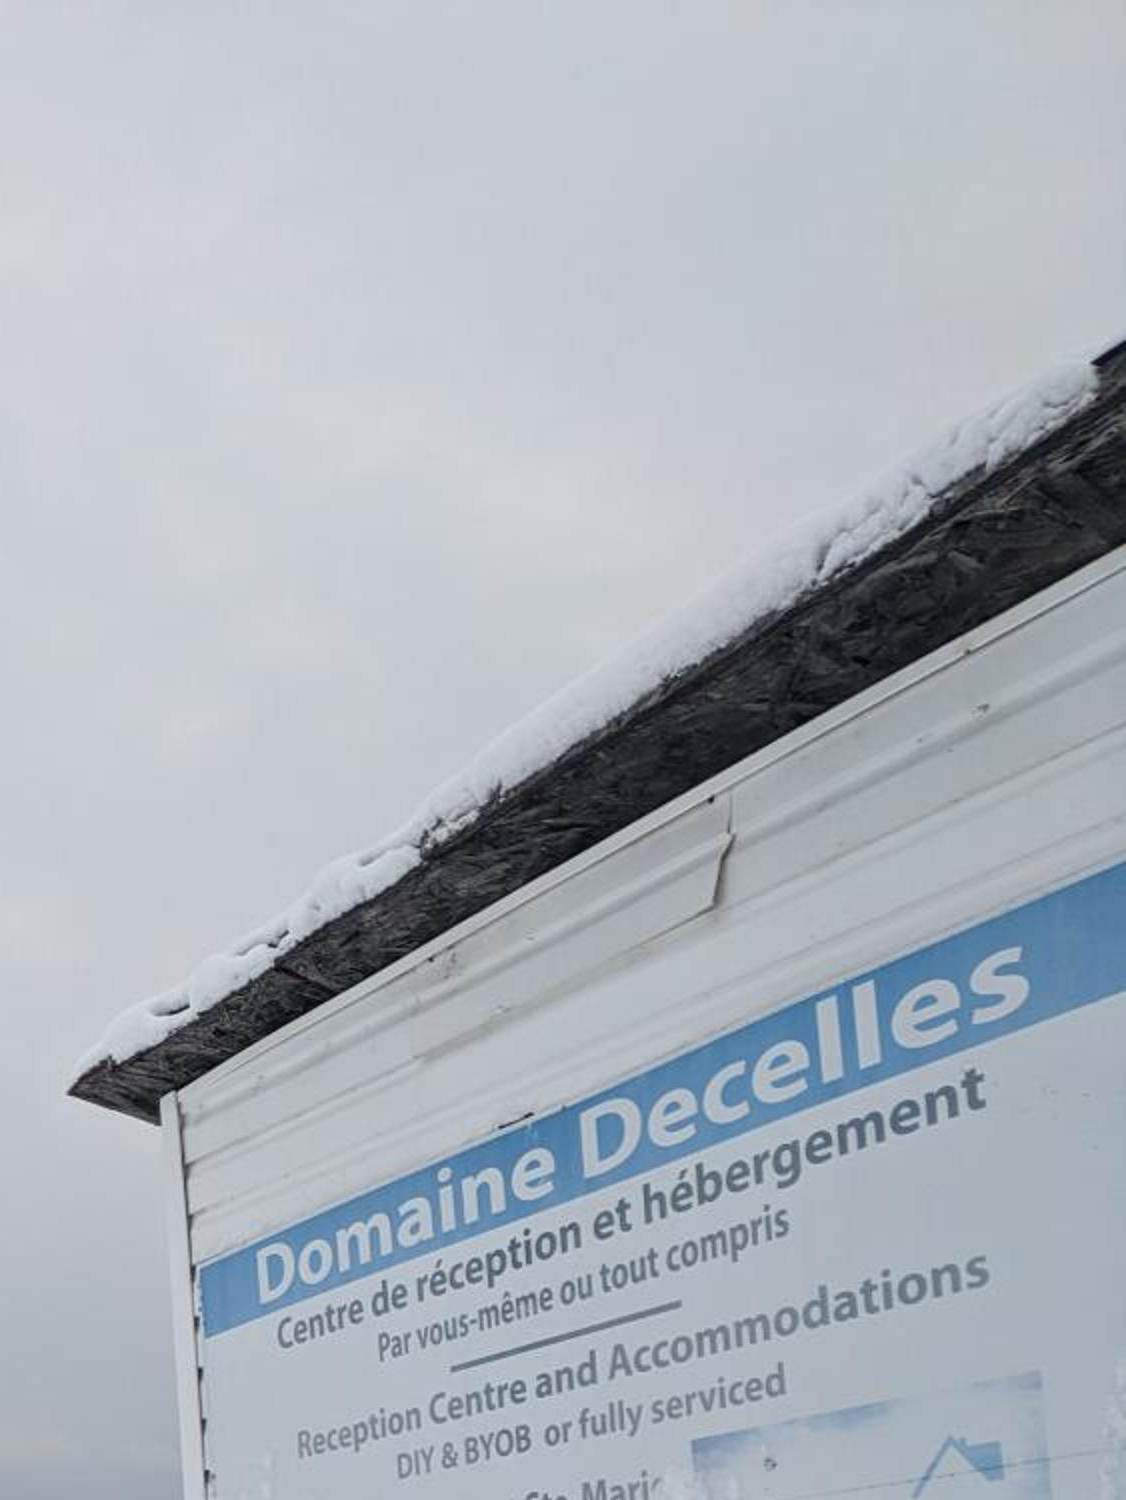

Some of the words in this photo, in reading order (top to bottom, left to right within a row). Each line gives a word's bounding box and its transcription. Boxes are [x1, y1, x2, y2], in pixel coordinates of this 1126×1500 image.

[257, 1144, 555, 1304] Domaine
[579, 946, 1030, 1179] Decelles
[277, 1299, 364, 1349] Centre
[371, 1279, 408, 1317] de
[416, 1219, 582, 1302] réception
[592, 1196, 632, 1241] et
[643, 1068, 987, 1225] hébergement
[297, 1406, 422, 1459] Reception
[429, 1378, 527, 1425] Centre
[535, 1350, 598, 1400] and
[608, 1255, 991, 1381] Accommodations
[378, 1331, 412, 1362] Par
[416, 1291, 554, 1350] vous-même
[560, 1275, 594, 1304] ou
[599, 1251, 659, 1292] tout
[665, 1204, 790, 1274] compris
[397, 1445, 434, 1479] DIY
[441, 1440, 459, 1469] &
[464, 1425, 531, 1465] BYOB
[544, 1420, 573, 1448] or
[579, 1400, 644, 1440] fully
[650, 1362, 788, 1425] serviced
